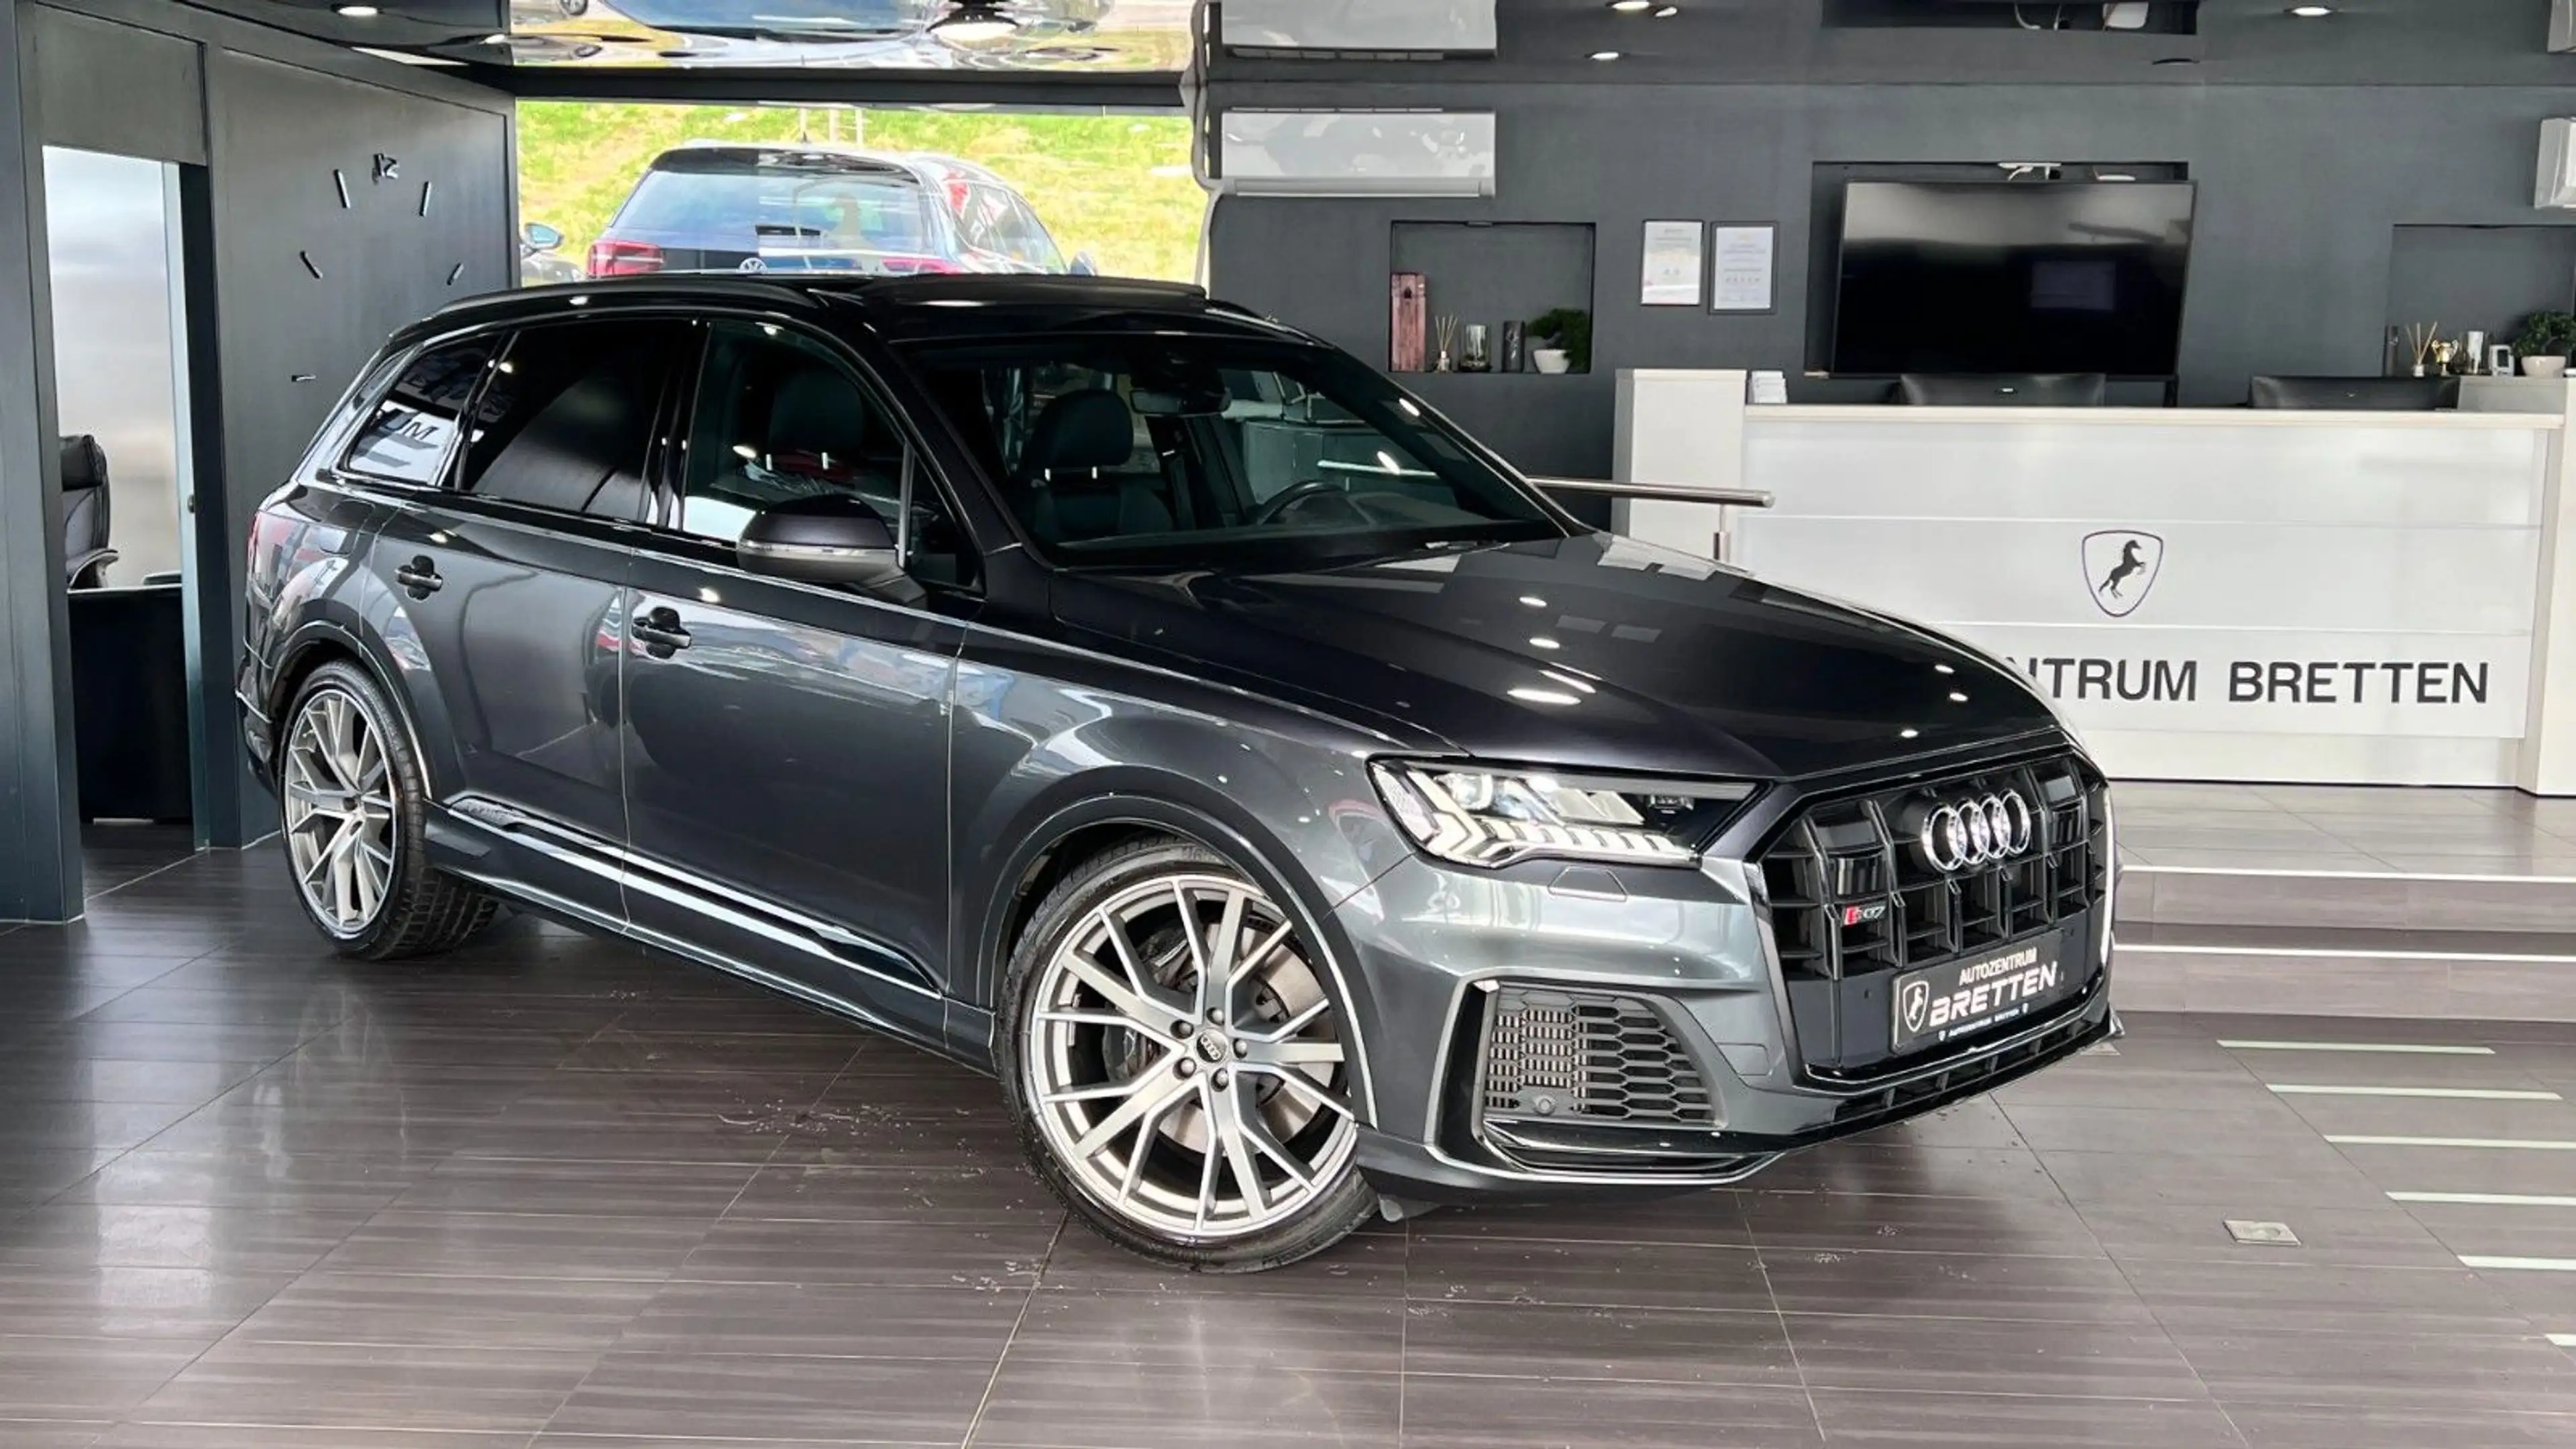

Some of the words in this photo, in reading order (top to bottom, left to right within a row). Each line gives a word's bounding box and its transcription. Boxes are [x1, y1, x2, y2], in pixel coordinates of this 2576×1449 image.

[2006, 656, 2197, 701] TRUM
[2229, 661, 2488, 703] BRETTEN
[1959, 947, 2037, 986] AUTOZENTRUM
[1929, 961, 2057, 1027] BRETTEN
